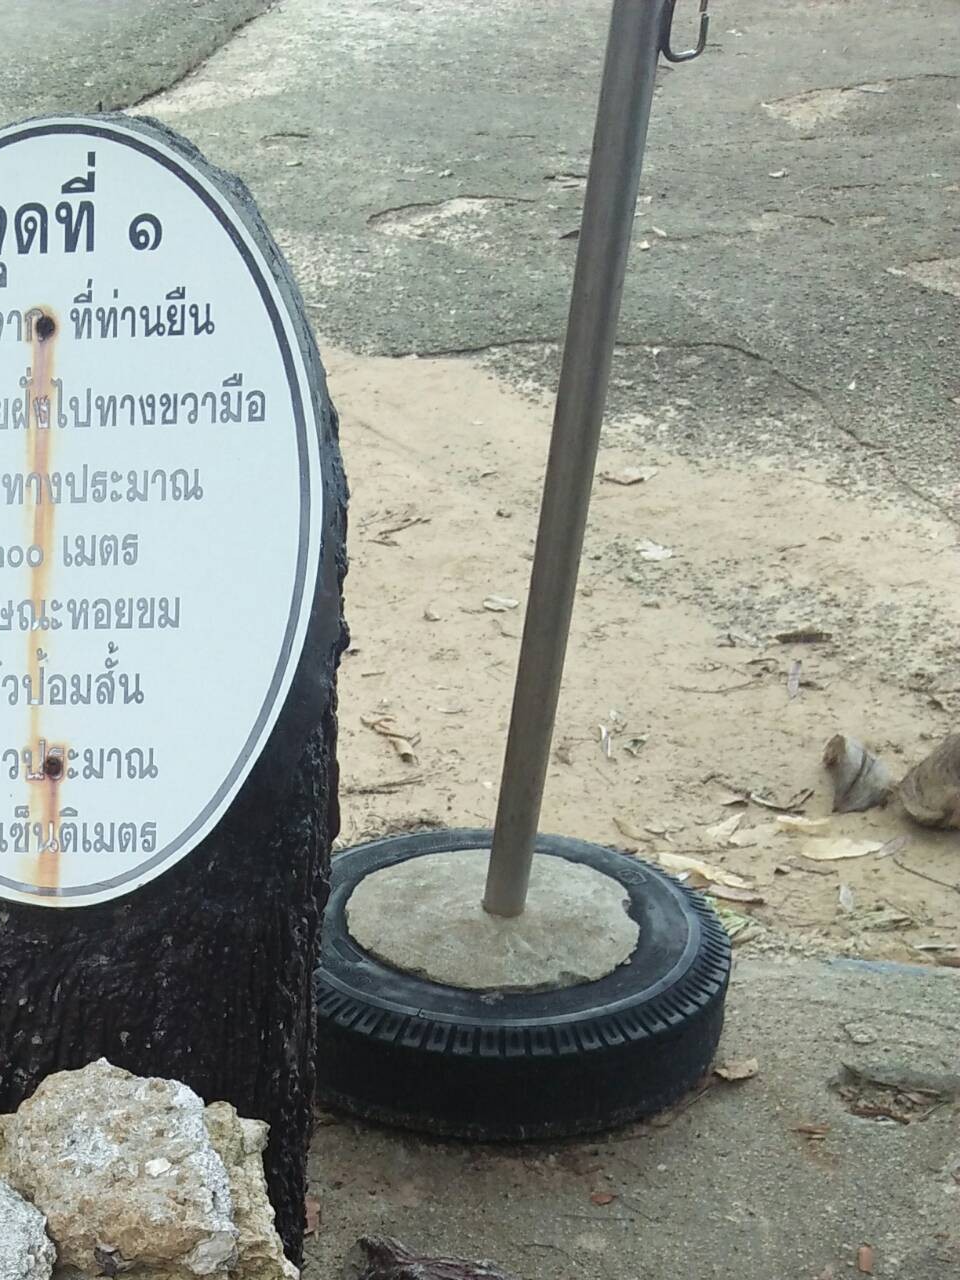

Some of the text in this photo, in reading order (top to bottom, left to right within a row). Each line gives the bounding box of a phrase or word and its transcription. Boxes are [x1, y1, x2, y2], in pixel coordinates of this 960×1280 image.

[128, 212, 164, 251] ๑
[69, 278, 216, 340] ที่ท่านยืน
[62, 533, 140, 567] เมตร
